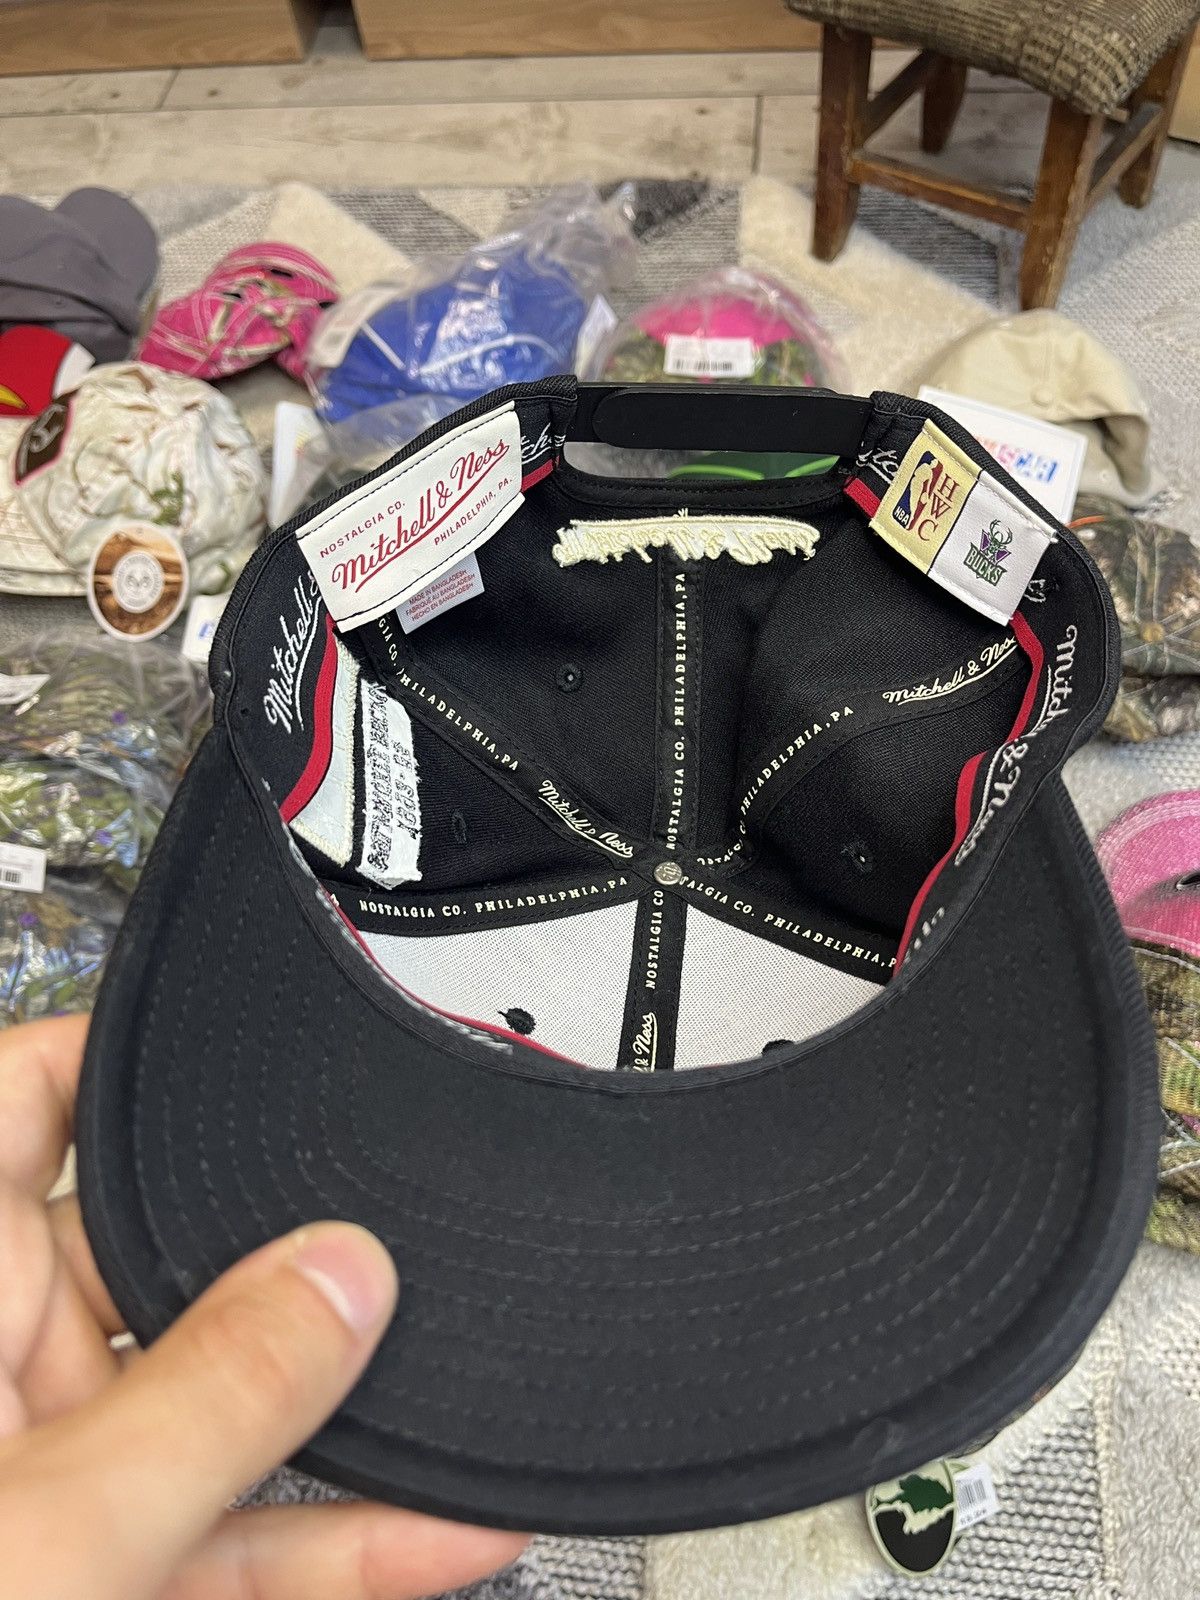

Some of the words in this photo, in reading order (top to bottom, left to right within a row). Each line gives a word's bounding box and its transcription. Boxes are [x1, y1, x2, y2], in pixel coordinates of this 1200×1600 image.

[320, 512, 385, 557] NOSTALGIA
[387, 500, 406, 515] CO.
[331, 488, 436, 590] Mitchell
[436, 480, 453, 508] &
[450, 438, 510, 491] Ness
[434, 491, 497, 546] PHILADELPHIA,
[893, 506, 910, 527] NBA
[409, 592, 426, 606] MADE
[431, 569, 467, 592] BANGLADESH
[440, 573, 476, 597] BANGLADESH
[964, 546, 1003, 586] BUCKS
[439, 582, 475, 606] BANGLADESH
[263, 576, 313, 735] Mitchell
[882, 666, 965, 703] Mitchell
[967, 660, 980, 676] &
[666, 769, 684, 849] NOSTALGIA
[675, 736, 685, 761] CO.
[539, 780, 589, 830] Mitchell
[599, 831, 634, 857] Ness
[359, 899, 436, 918] NOSTALGIA
[442, 904, 467, 917] CO.
[645, 911, 663, 990] NOSTALGIA
[733, 900, 755, 917] CO.
[763, 913, 898, 968] PHILADELPHIA,P
[632, 1012, 655, 1055] Ness
